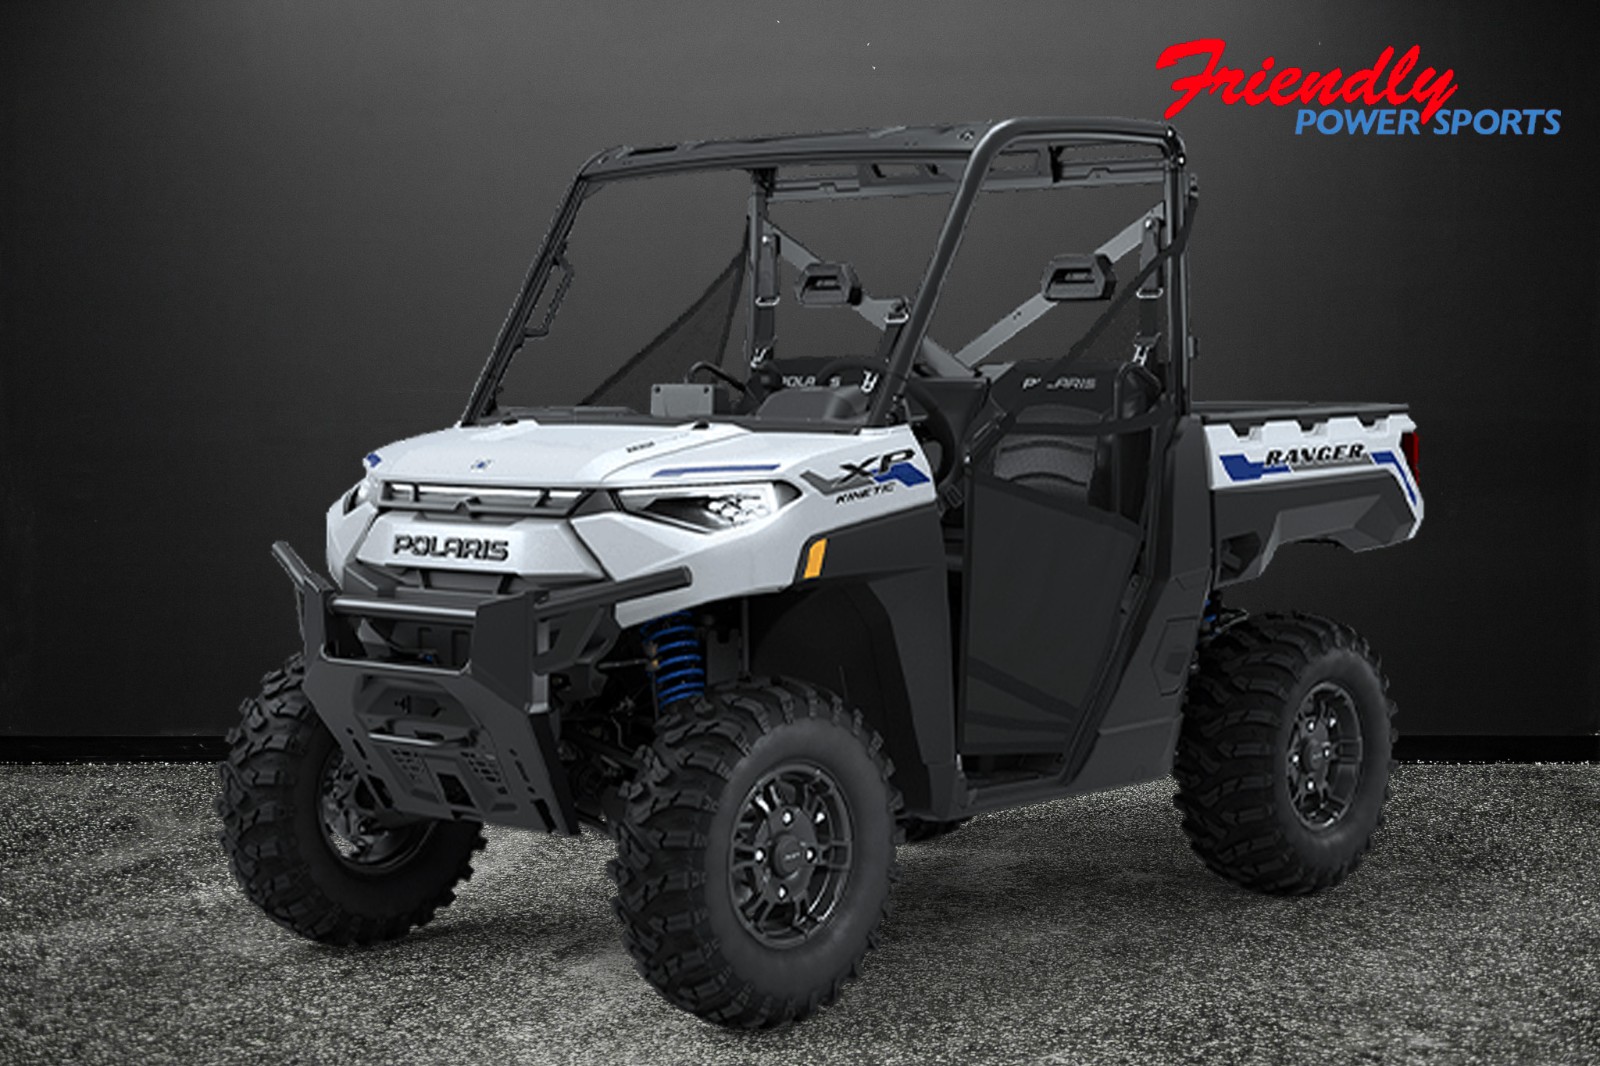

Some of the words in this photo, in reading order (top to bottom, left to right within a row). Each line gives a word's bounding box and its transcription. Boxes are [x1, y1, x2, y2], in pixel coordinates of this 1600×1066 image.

[1023, 377, 1096, 390] PARIS
[837, 448, 916, 483] XP
[1264, 443, 1365, 467] RANGER
[836, 482, 896, 504] KINETIC
[393, 534, 509, 561] POLARIS
